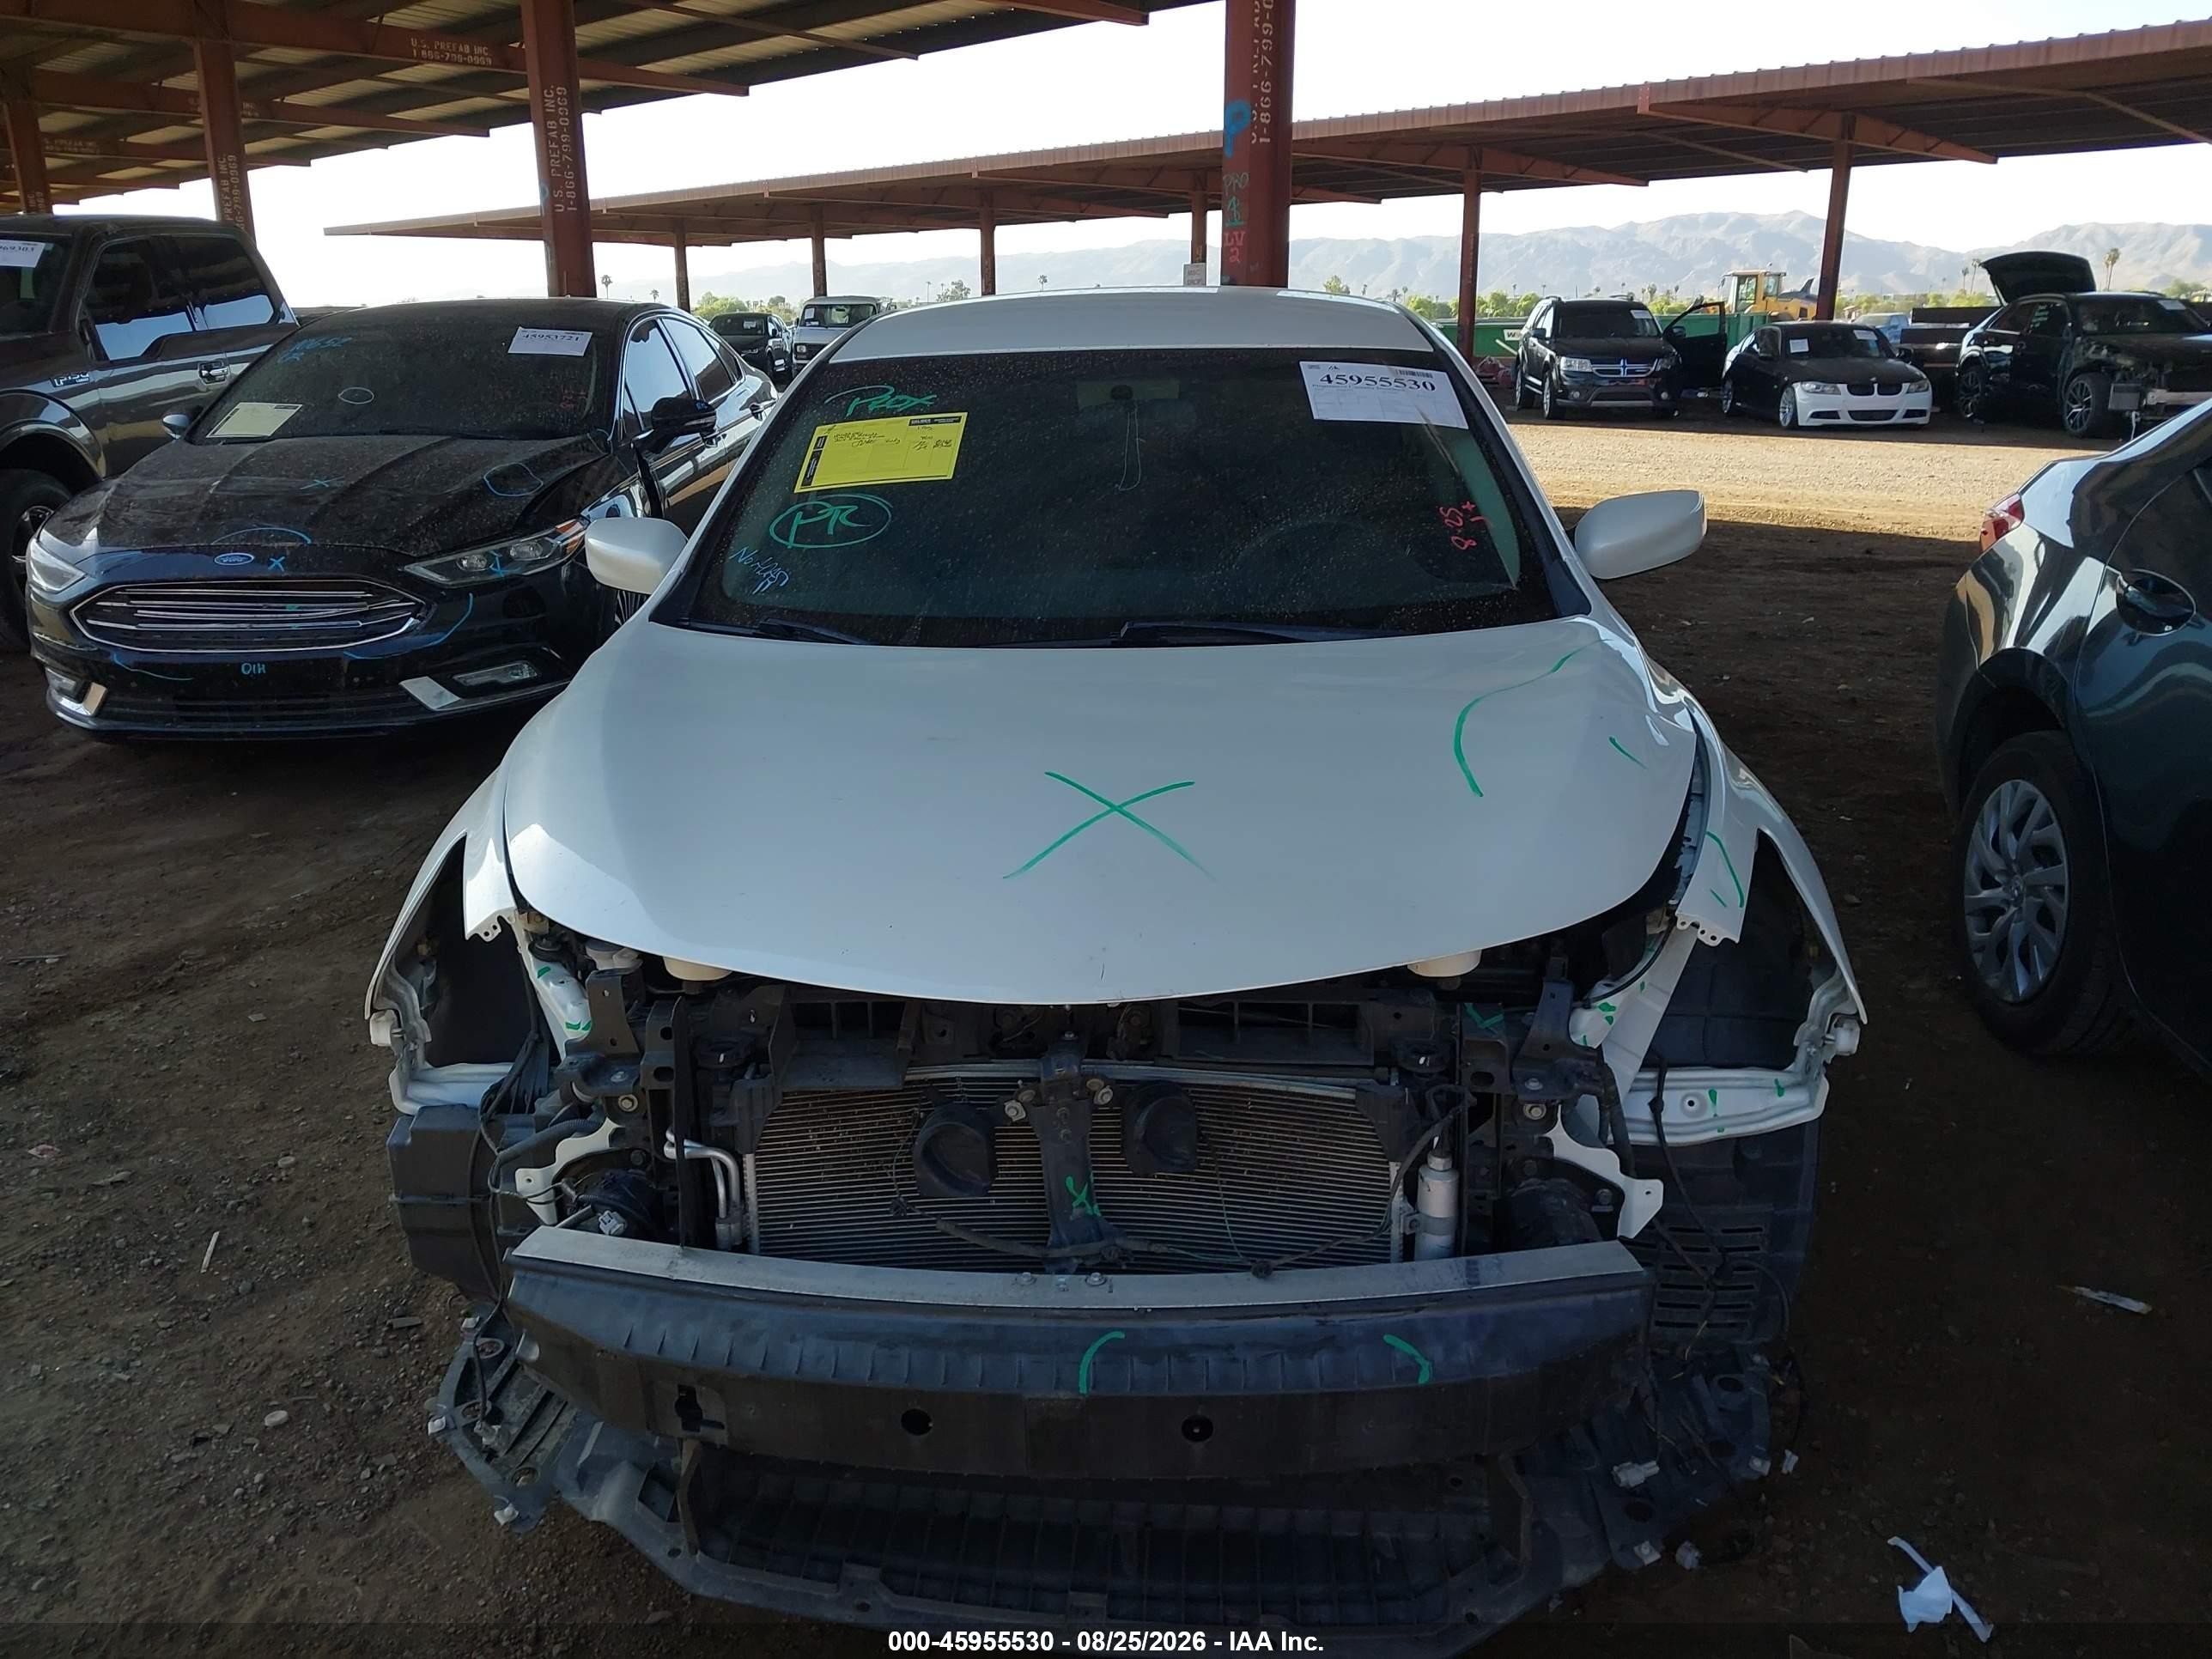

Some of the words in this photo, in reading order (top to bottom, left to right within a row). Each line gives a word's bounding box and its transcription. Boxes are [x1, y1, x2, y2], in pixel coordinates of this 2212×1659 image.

[434, 40, 471, 53] PREFAB
[546, 120, 562, 177] PREFAB
[1319, 373, 1437, 392] 45955530
